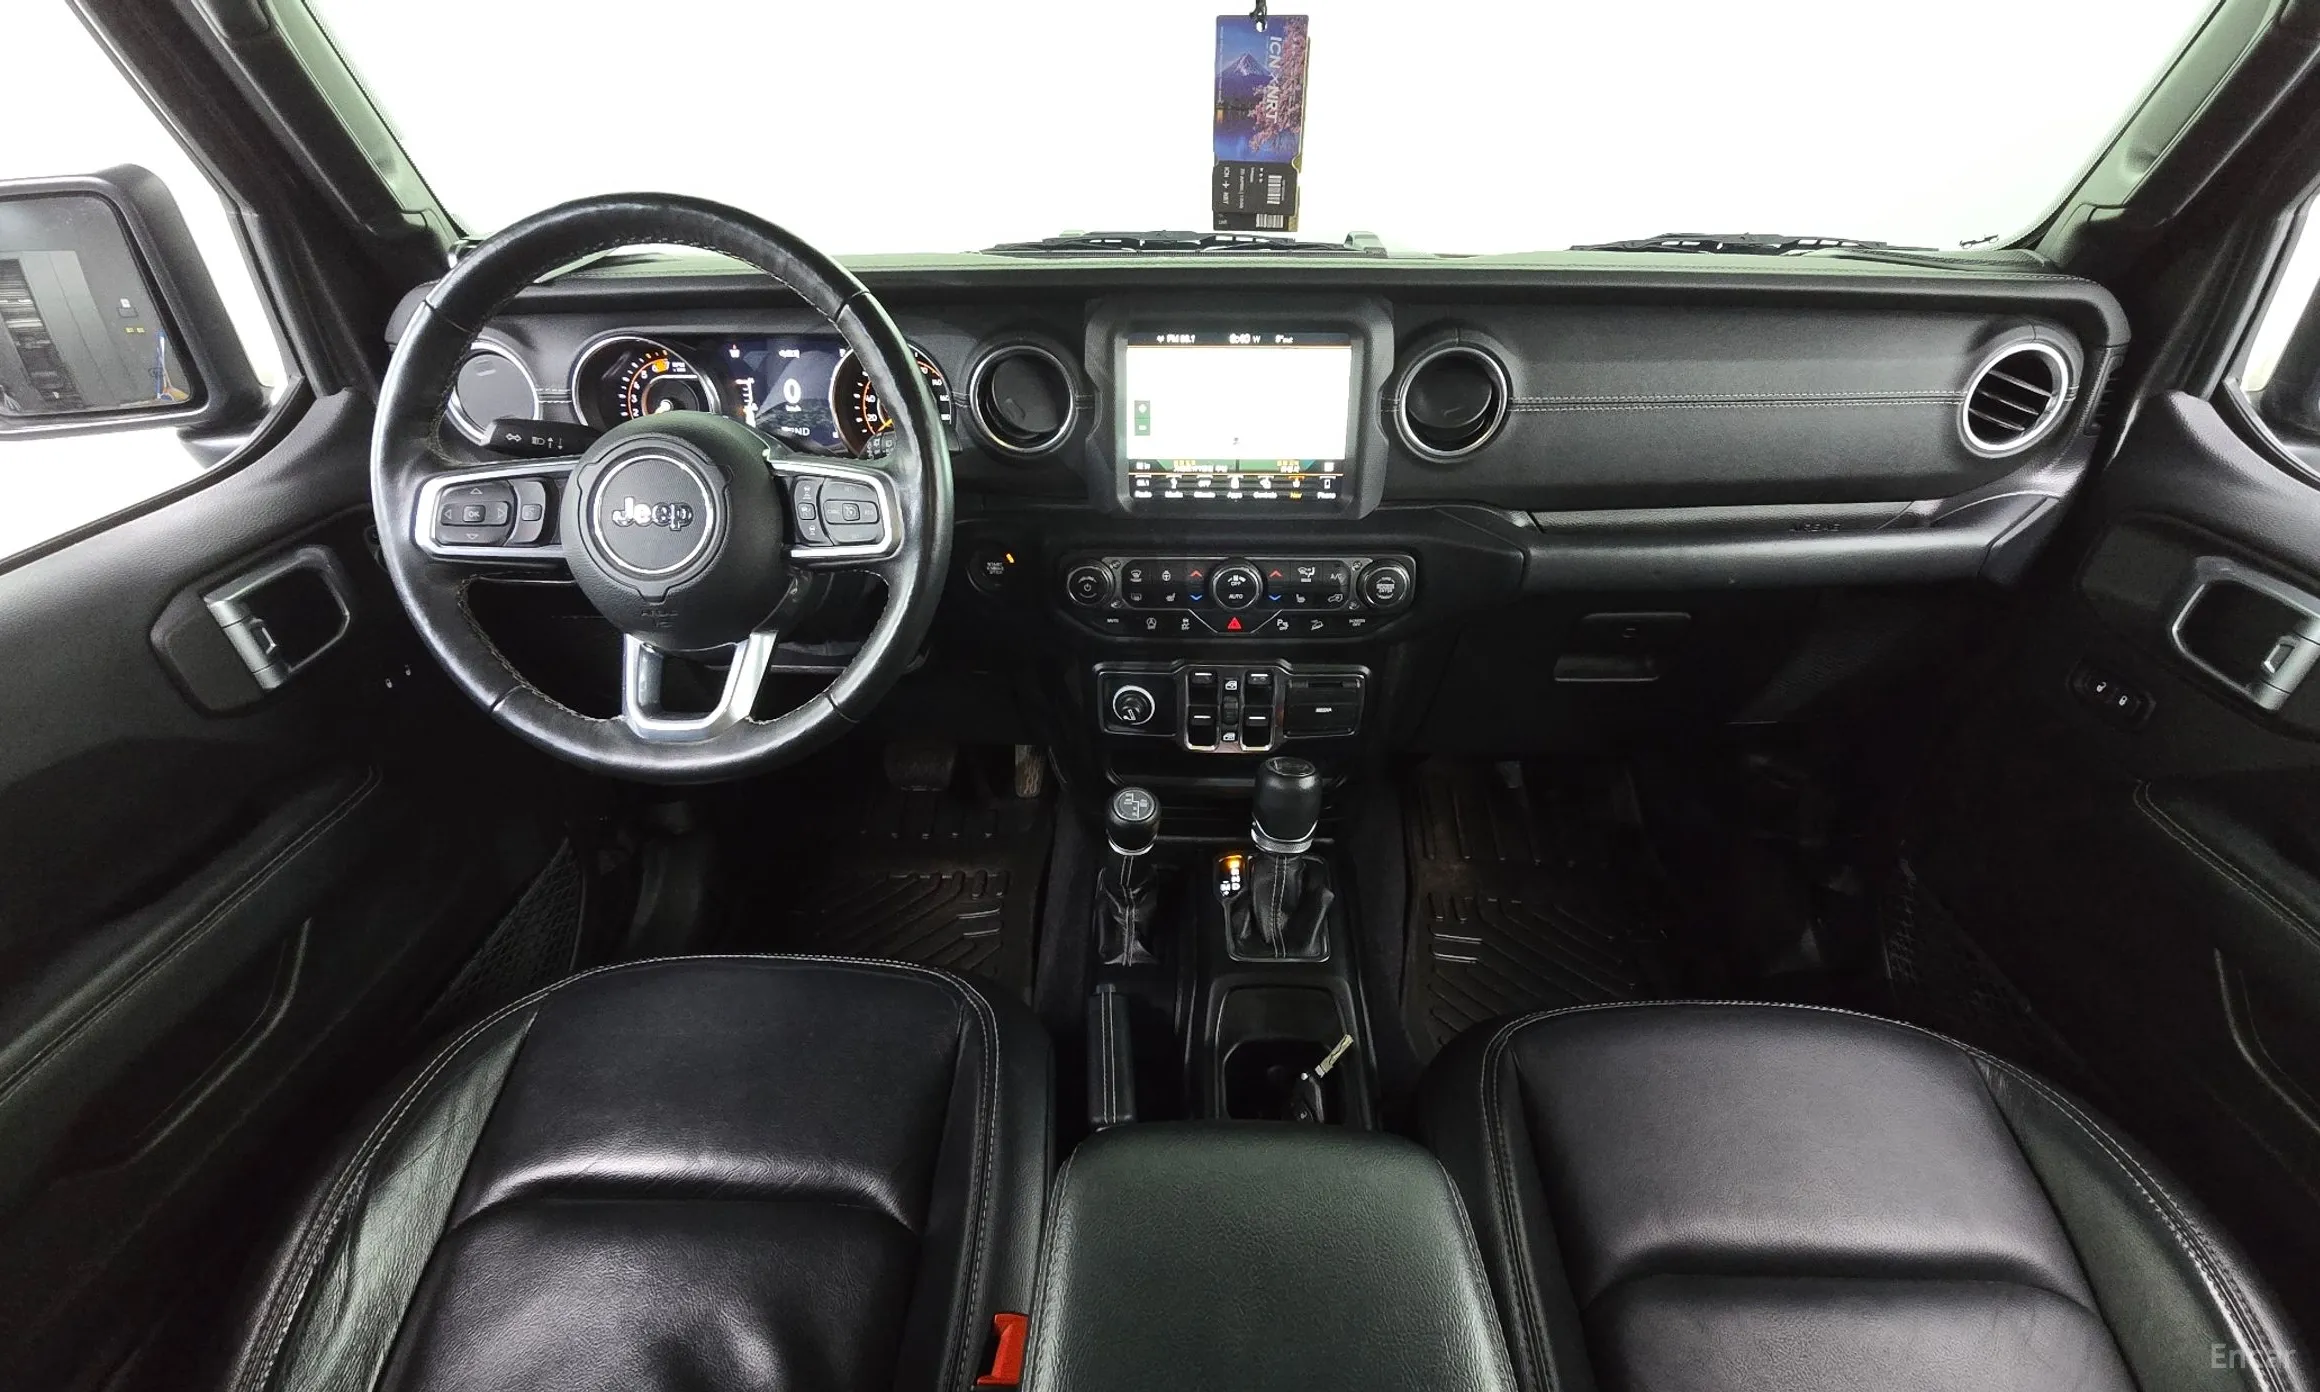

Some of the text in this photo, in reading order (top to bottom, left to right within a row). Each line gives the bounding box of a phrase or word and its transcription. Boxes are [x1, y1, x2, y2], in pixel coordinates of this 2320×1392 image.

[1269, 36, 1282, 69] ICN
[783, 378, 801, 404] 0
[612, 496, 694, 531] Jeep
